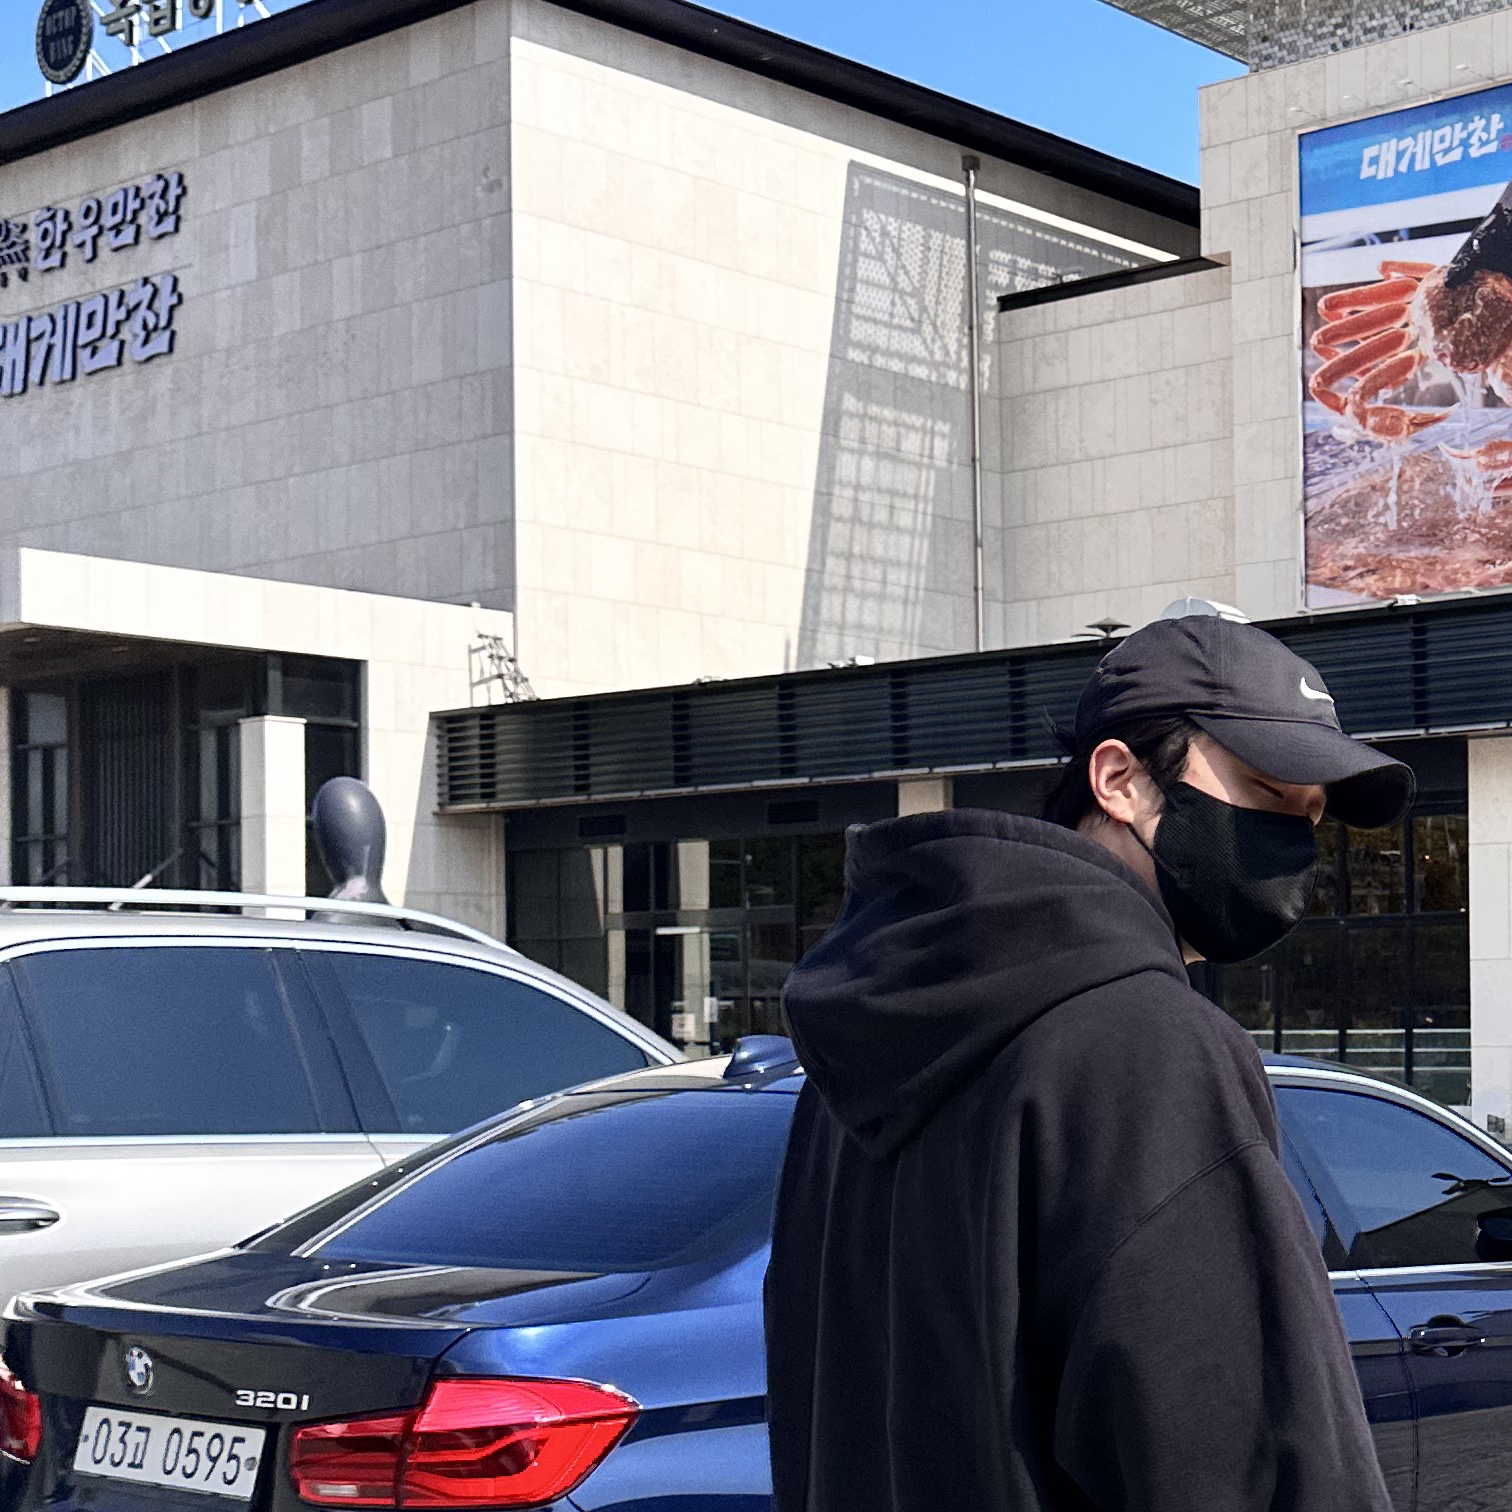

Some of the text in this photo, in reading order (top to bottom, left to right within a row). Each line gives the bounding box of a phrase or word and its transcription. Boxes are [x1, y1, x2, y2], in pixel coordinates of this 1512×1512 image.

[1359, 113, 1504, 180] 대게만찬
[34, 172, 187, 272] 한우만찬
[162, 1426, 247, 1486] 0595
